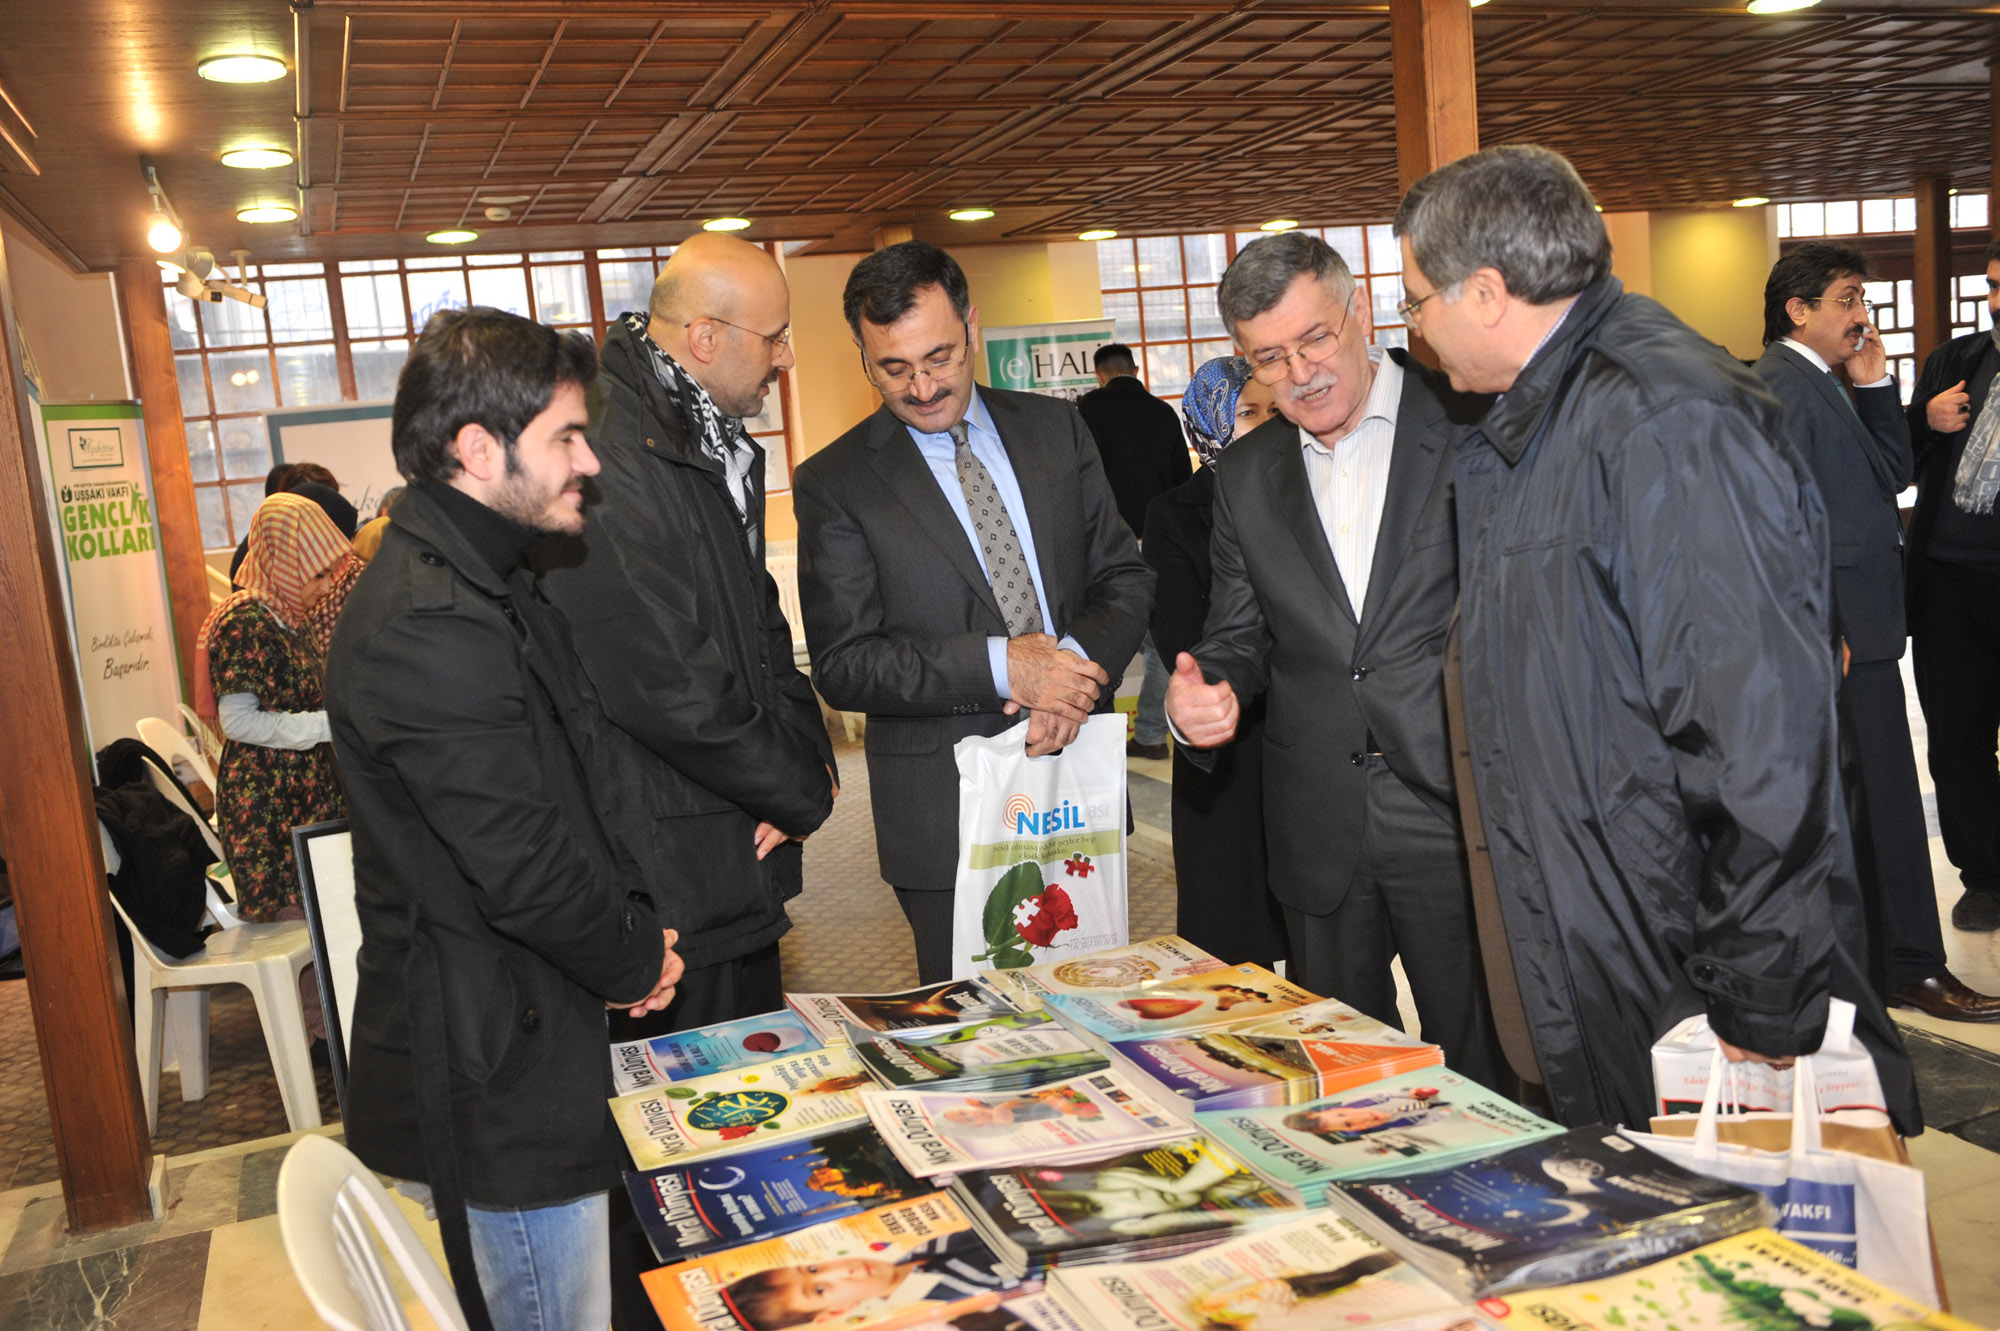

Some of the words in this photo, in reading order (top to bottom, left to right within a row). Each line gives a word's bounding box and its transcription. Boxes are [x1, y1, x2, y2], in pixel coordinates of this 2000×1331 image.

[1035, 343, 1101, 378] HAL
[66, 526, 157, 563] KOLLARI
[1017, 800, 1085, 835] NESİL
[1081, 834, 1096, 846] hep
[619, 1044, 650, 1072] Dünyası
[1140, 1044, 1202, 1079] Dünyası
[631, 1069, 658, 1088] Moral
[1187, 1073, 1231, 1093] Moral
[639, 1098, 675, 1139] Dünyası
[889, 1099, 934, 1144] Dünyası
[1227, 1116, 1287, 1156] Dünyası
[659, 1134, 688, 1157] Moral
[919, 1137, 959, 1166] Moral
[1281, 1151, 1331, 1175] Moral
[655, 1174, 697, 1226] Dünyası
[989, 1174, 1045, 1220] Dünyası
[670, 1215, 709, 1247] Moral
[677, 1266, 728, 1321] Dünyası
